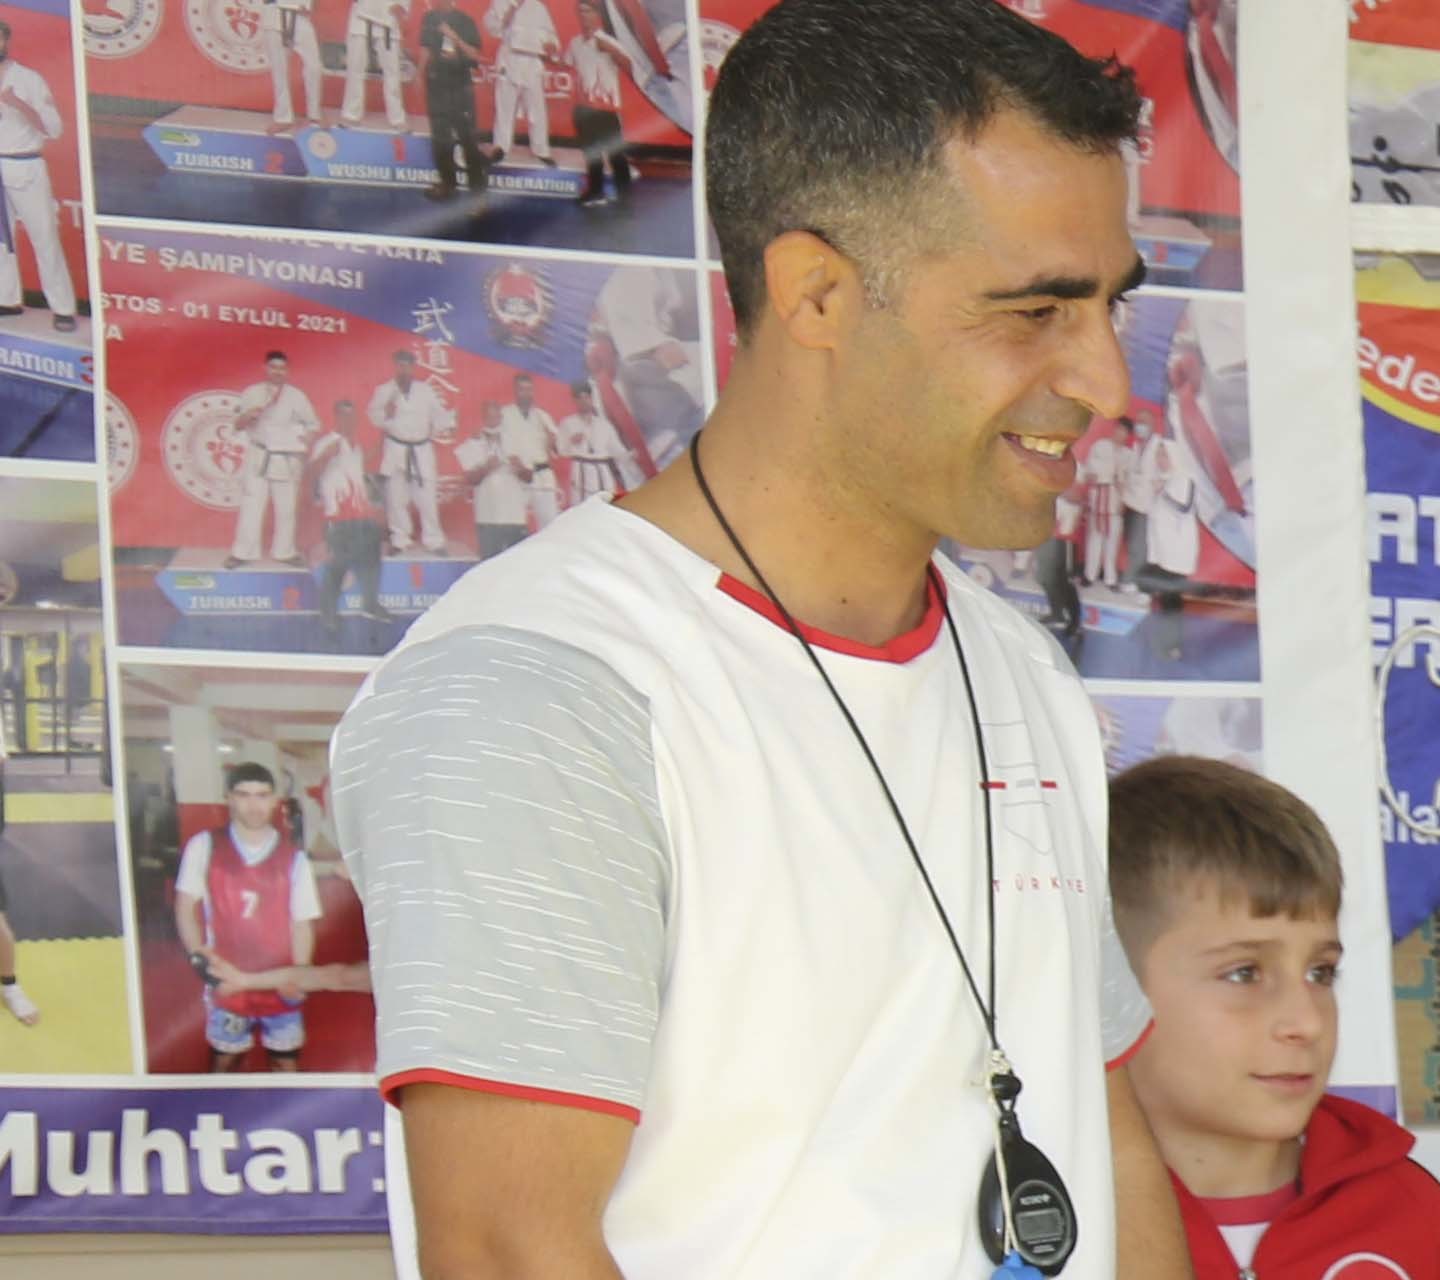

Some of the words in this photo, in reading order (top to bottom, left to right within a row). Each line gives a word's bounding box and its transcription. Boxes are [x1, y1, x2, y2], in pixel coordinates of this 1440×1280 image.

[174, 150, 255, 171] TURKISH
[326, 162, 392, 182] WUSHU
[159, 246, 365, 291] ŞAMPİYONASI
[182, 301, 210, 321] 01
[218, 304, 293, 331] EYLÜL
[297, 313, 348, 335] 2021
